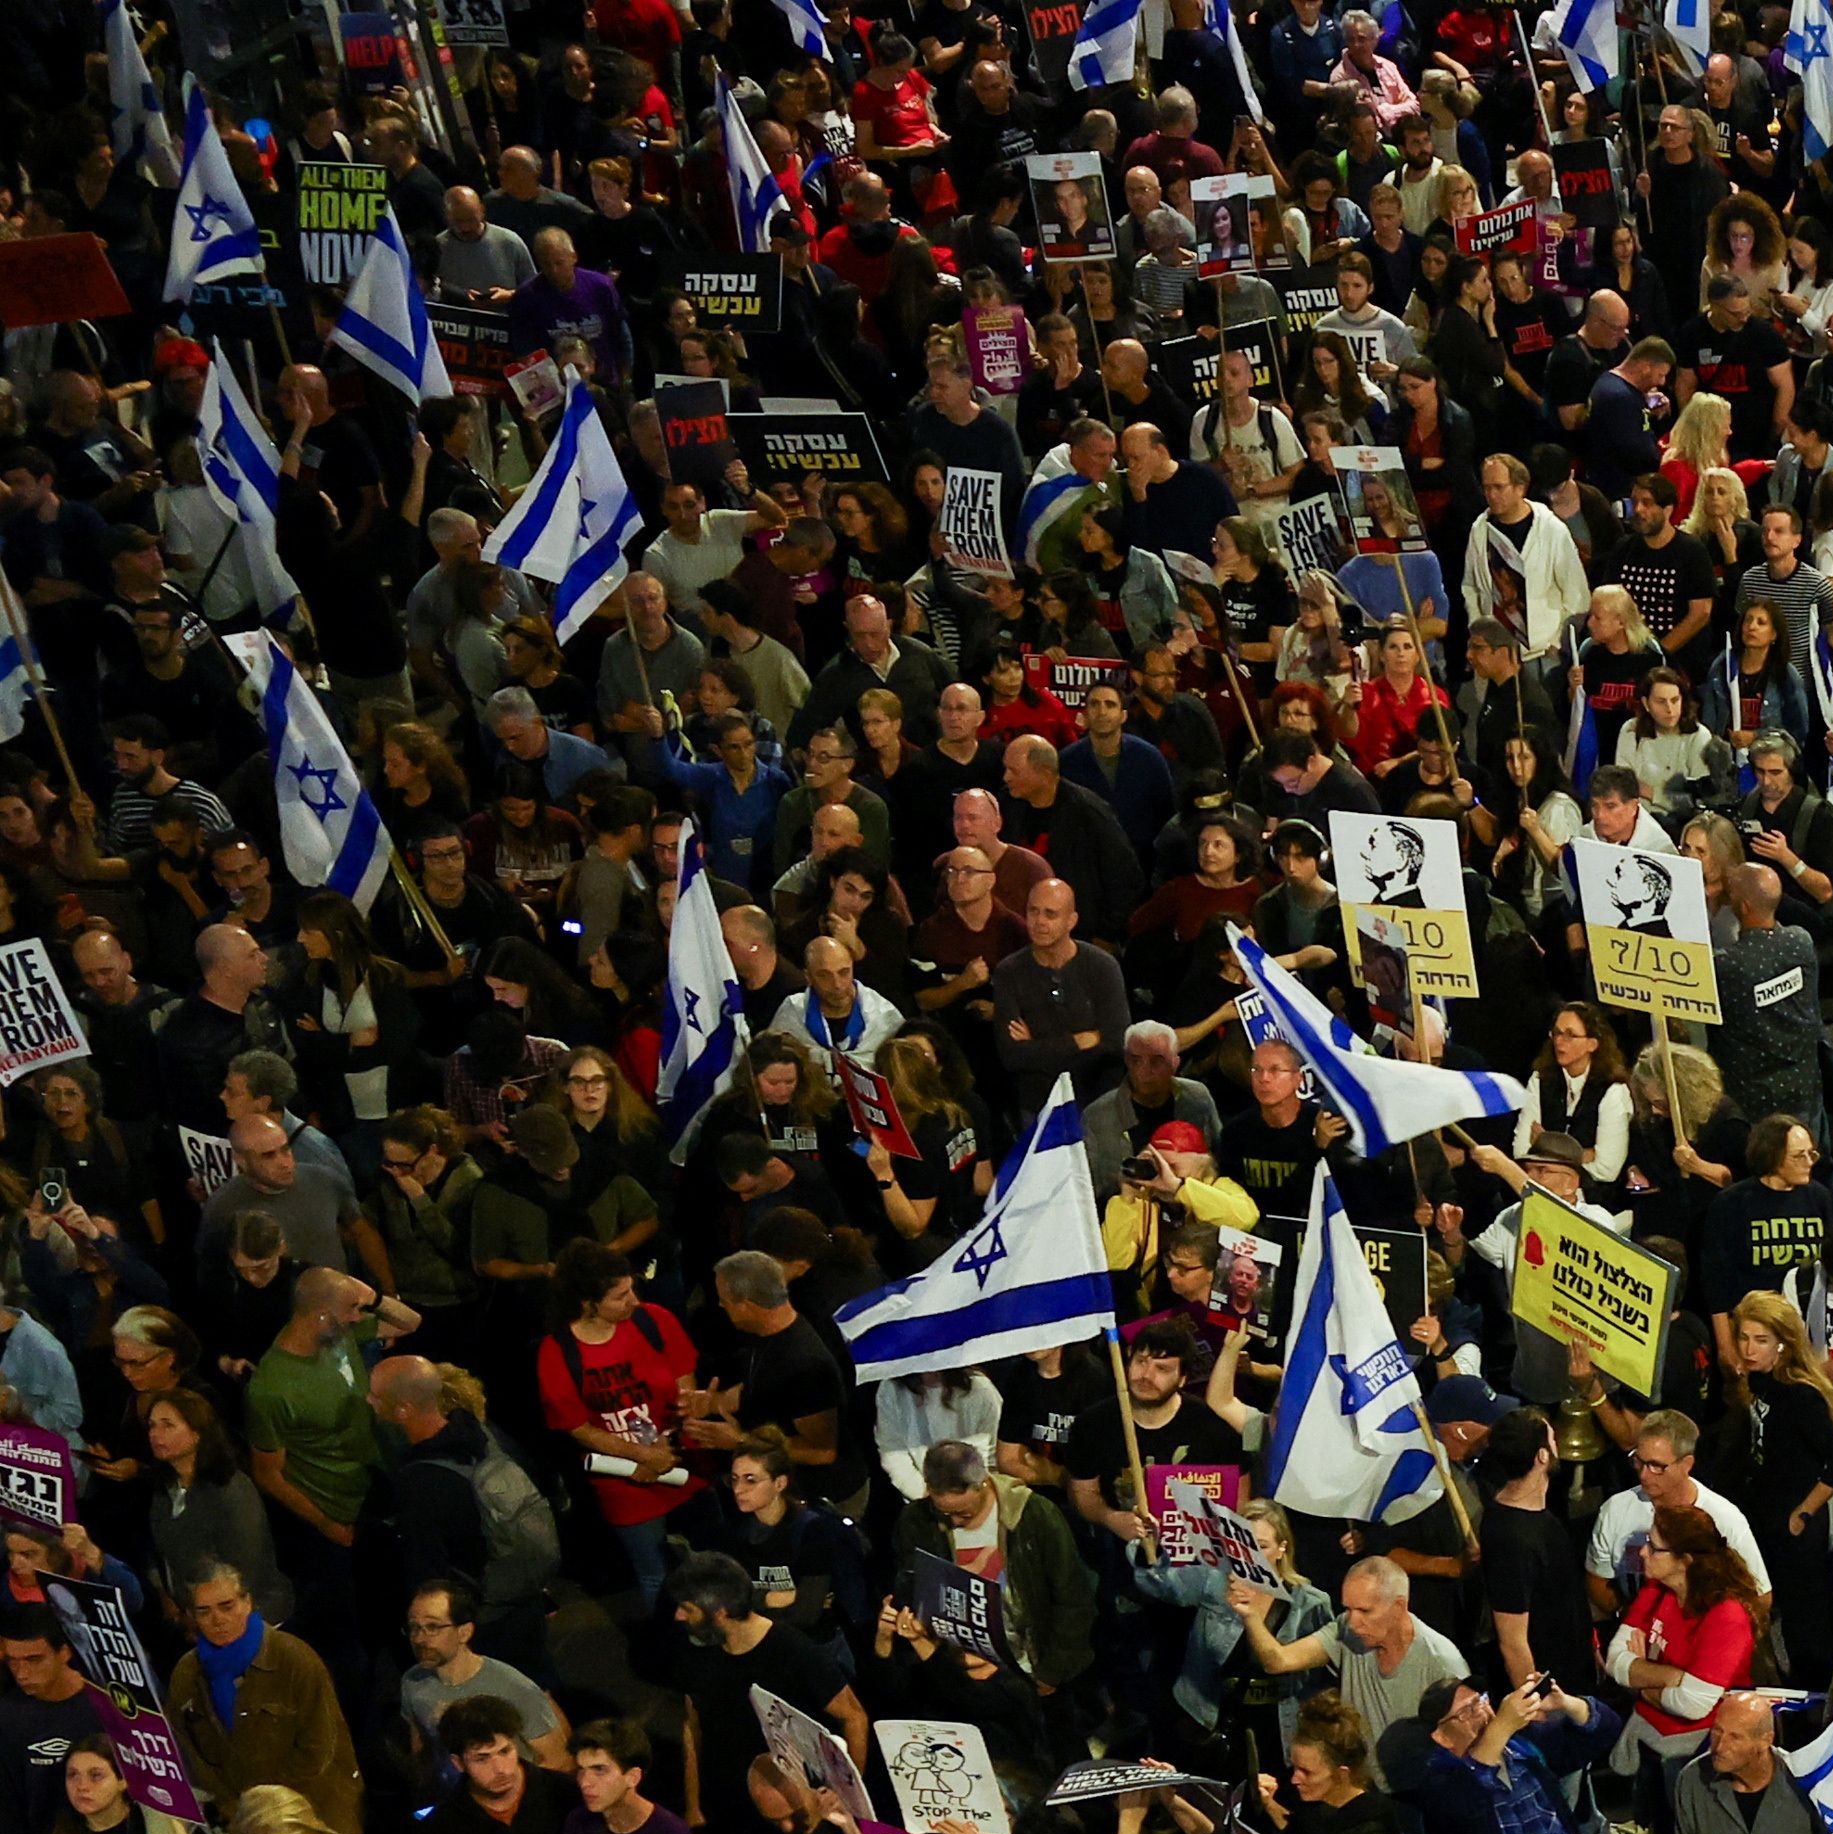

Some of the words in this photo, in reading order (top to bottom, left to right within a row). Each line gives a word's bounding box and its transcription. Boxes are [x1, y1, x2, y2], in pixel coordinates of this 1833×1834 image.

[1030, 4, 1082, 39] הצילו
[342, 166, 386, 191] THEM
[299, 193, 385, 230] HOME
[1515, 204, 1534, 224] את
[684, 272, 757, 295] עסקה
[1285, 288, 1339, 310] עסקה
[764, 433, 847, 454] עסקה
[766, 453, 861, 470] עכשיו!
[950, 475, 995, 508] SAVE
[945, 502, 995, 534] THEM
[1279, 500, 1328, 538] SAVE
[1611, 936, 1692, 979] 7/10
[1416, 970, 1472, 990] הדחה
[1600, 980, 1652, 1003] עכשיו
[1662, 994, 1717, 1016] הדחה
[1750, 1216, 1824, 1241] הדחה
[1558, 1233, 1592, 1264] הוא
[1751, 1243, 1821, 1266] עכשיו
[1551, 1261, 1596, 1297] כולנו
[1594, 1257, 1653, 1307] הצלצול
[1596, 1285, 1651, 1336] בשביל
[1356, 1344, 1403, 1377] חופשי
[131, 1729, 170, 1755] דרך
[118, 1742, 183, 1782] השלום
[912, 1805, 952, 1819] STOP
[957, 1808, 992, 1821] The
